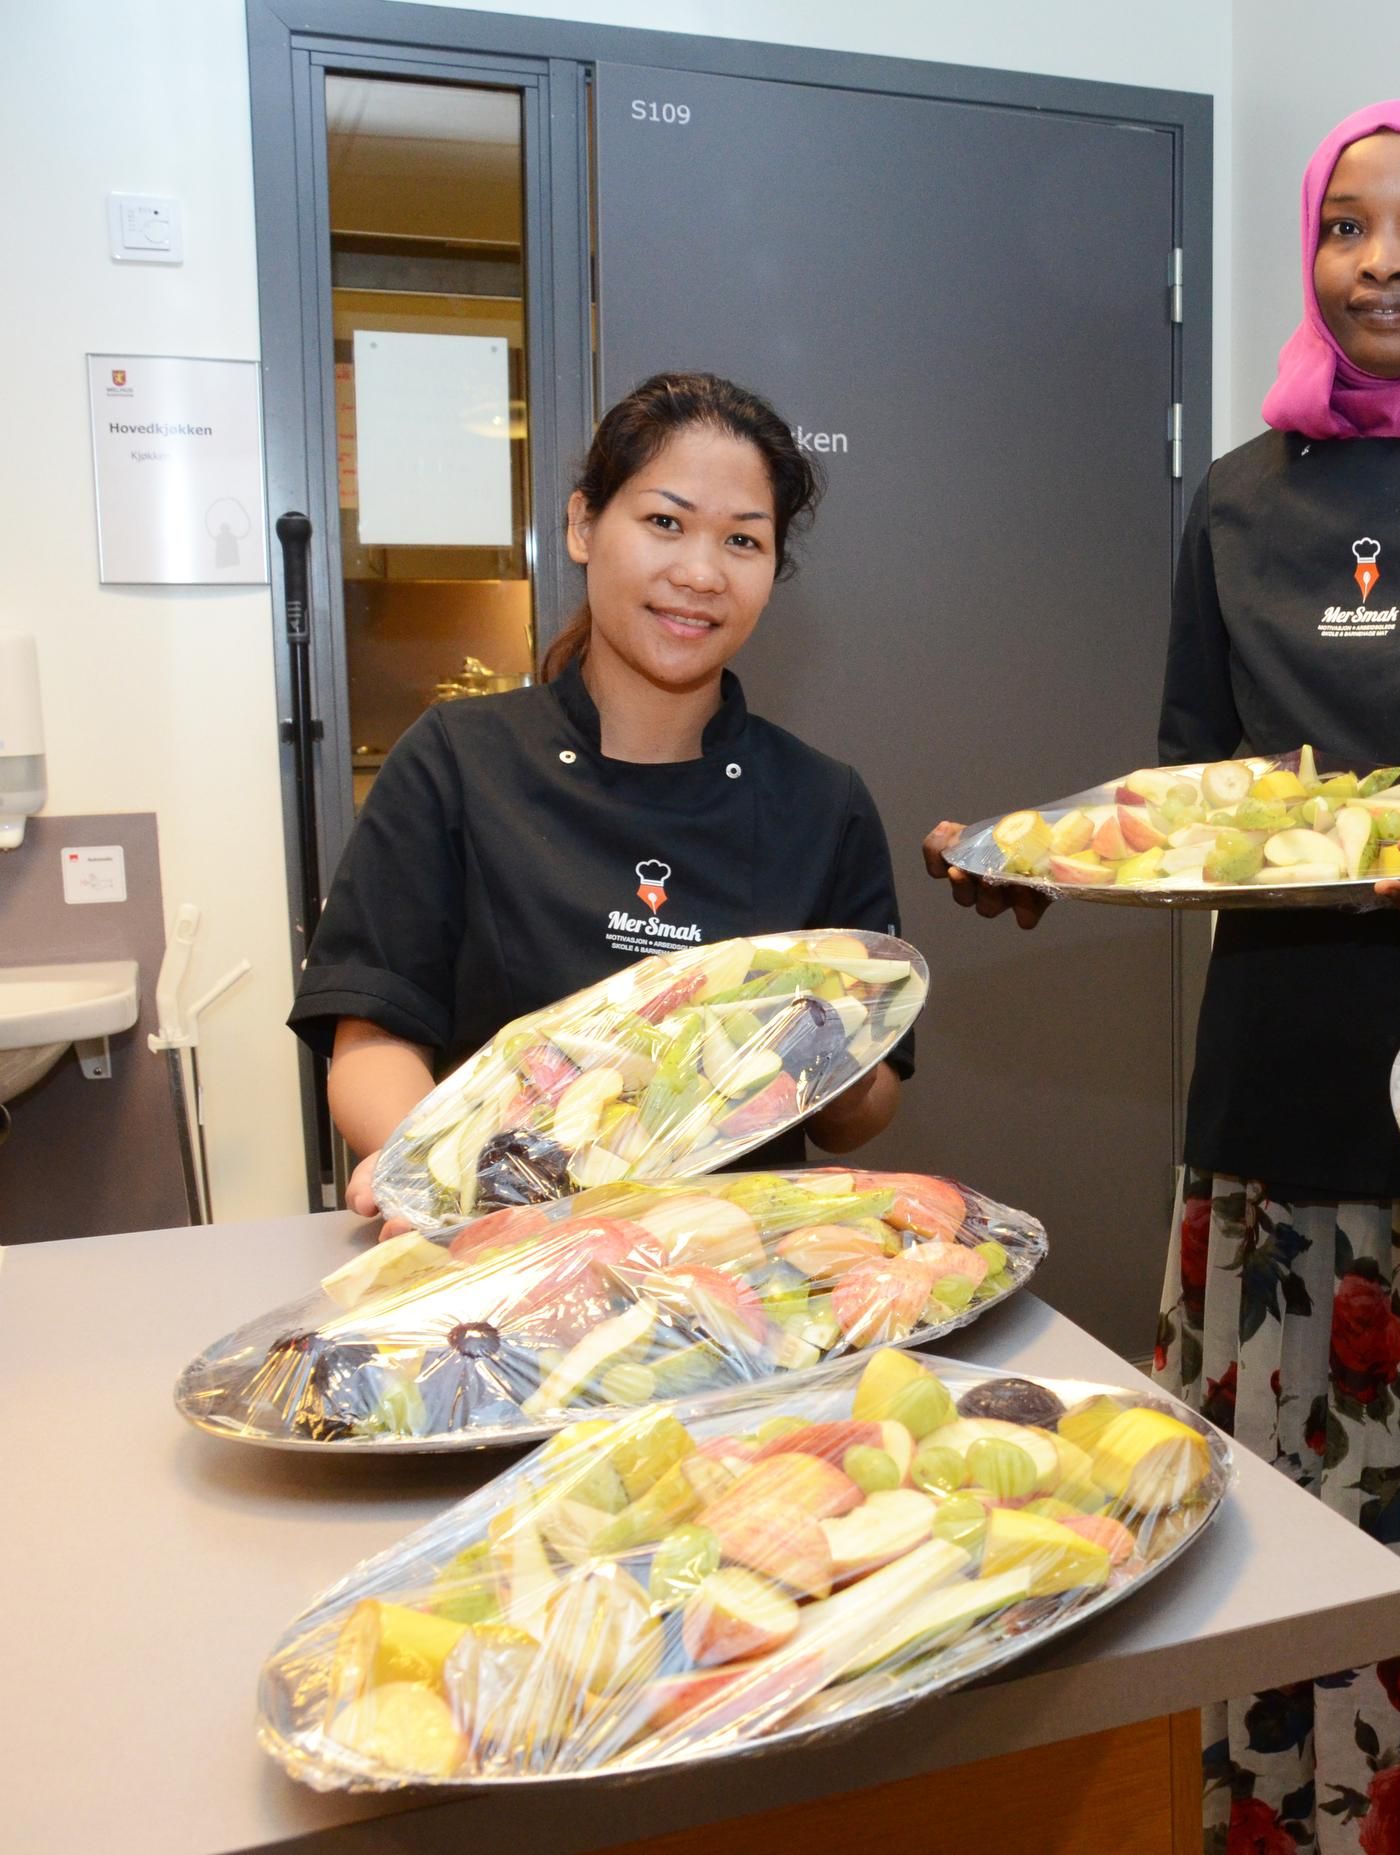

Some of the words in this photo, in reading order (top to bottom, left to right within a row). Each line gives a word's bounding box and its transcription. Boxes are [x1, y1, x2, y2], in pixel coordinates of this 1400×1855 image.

[631, 99, 691, 125] S109
[109, 422, 213, 436] Hovedkjøkken
[605, 933, 648, 946] MOTIVASJON
[611, 942, 634, 952] SKOLE
[634, 945, 640, 953] &
